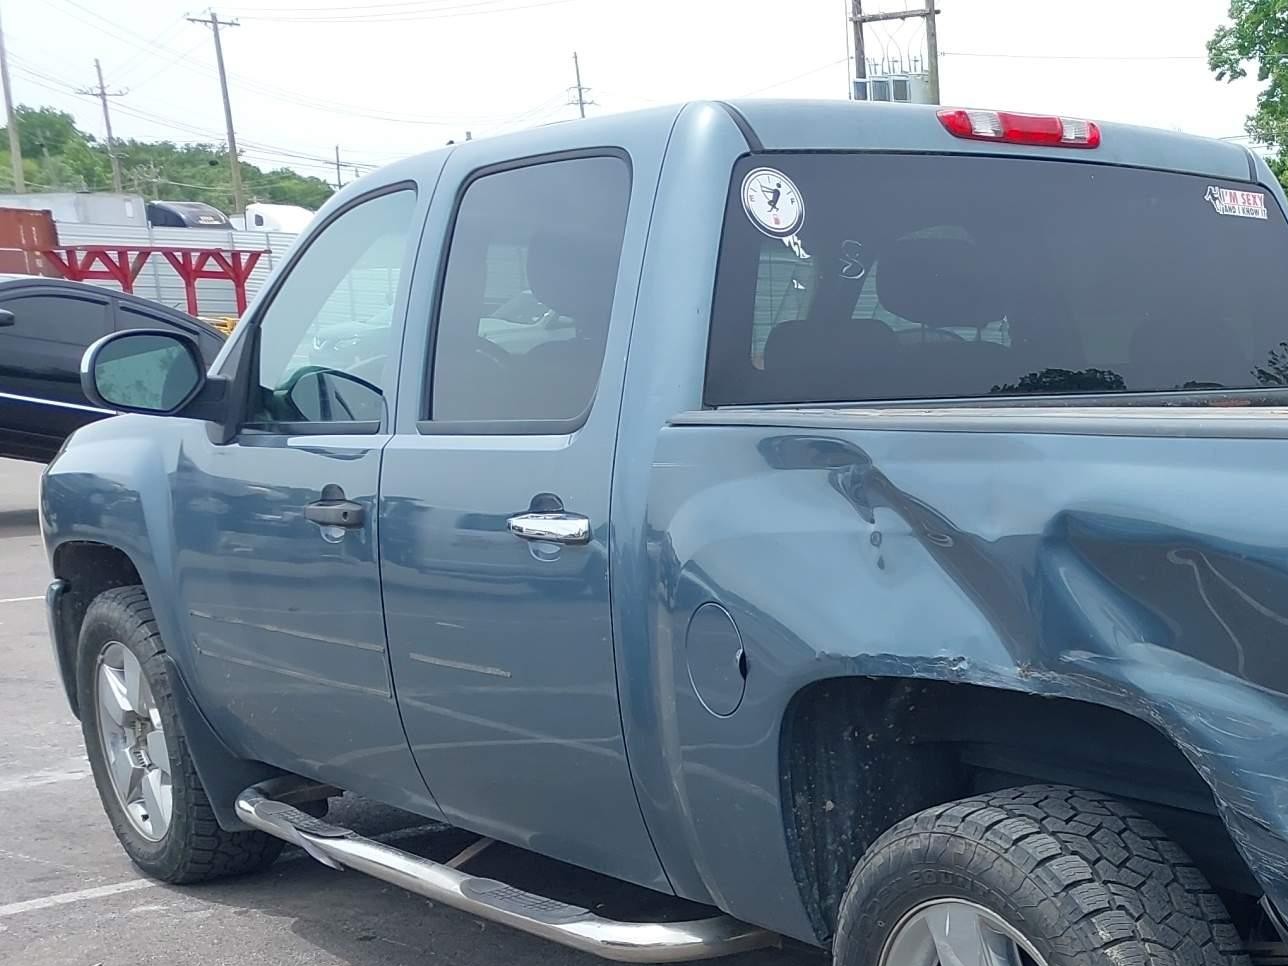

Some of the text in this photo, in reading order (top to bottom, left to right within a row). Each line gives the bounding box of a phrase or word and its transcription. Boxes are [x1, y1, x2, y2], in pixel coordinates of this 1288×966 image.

[1221, 190, 1264, 208] I'M SEXY
[1224, 204, 1237, 214] AND
[1242, 206, 1260, 217] KNOW
